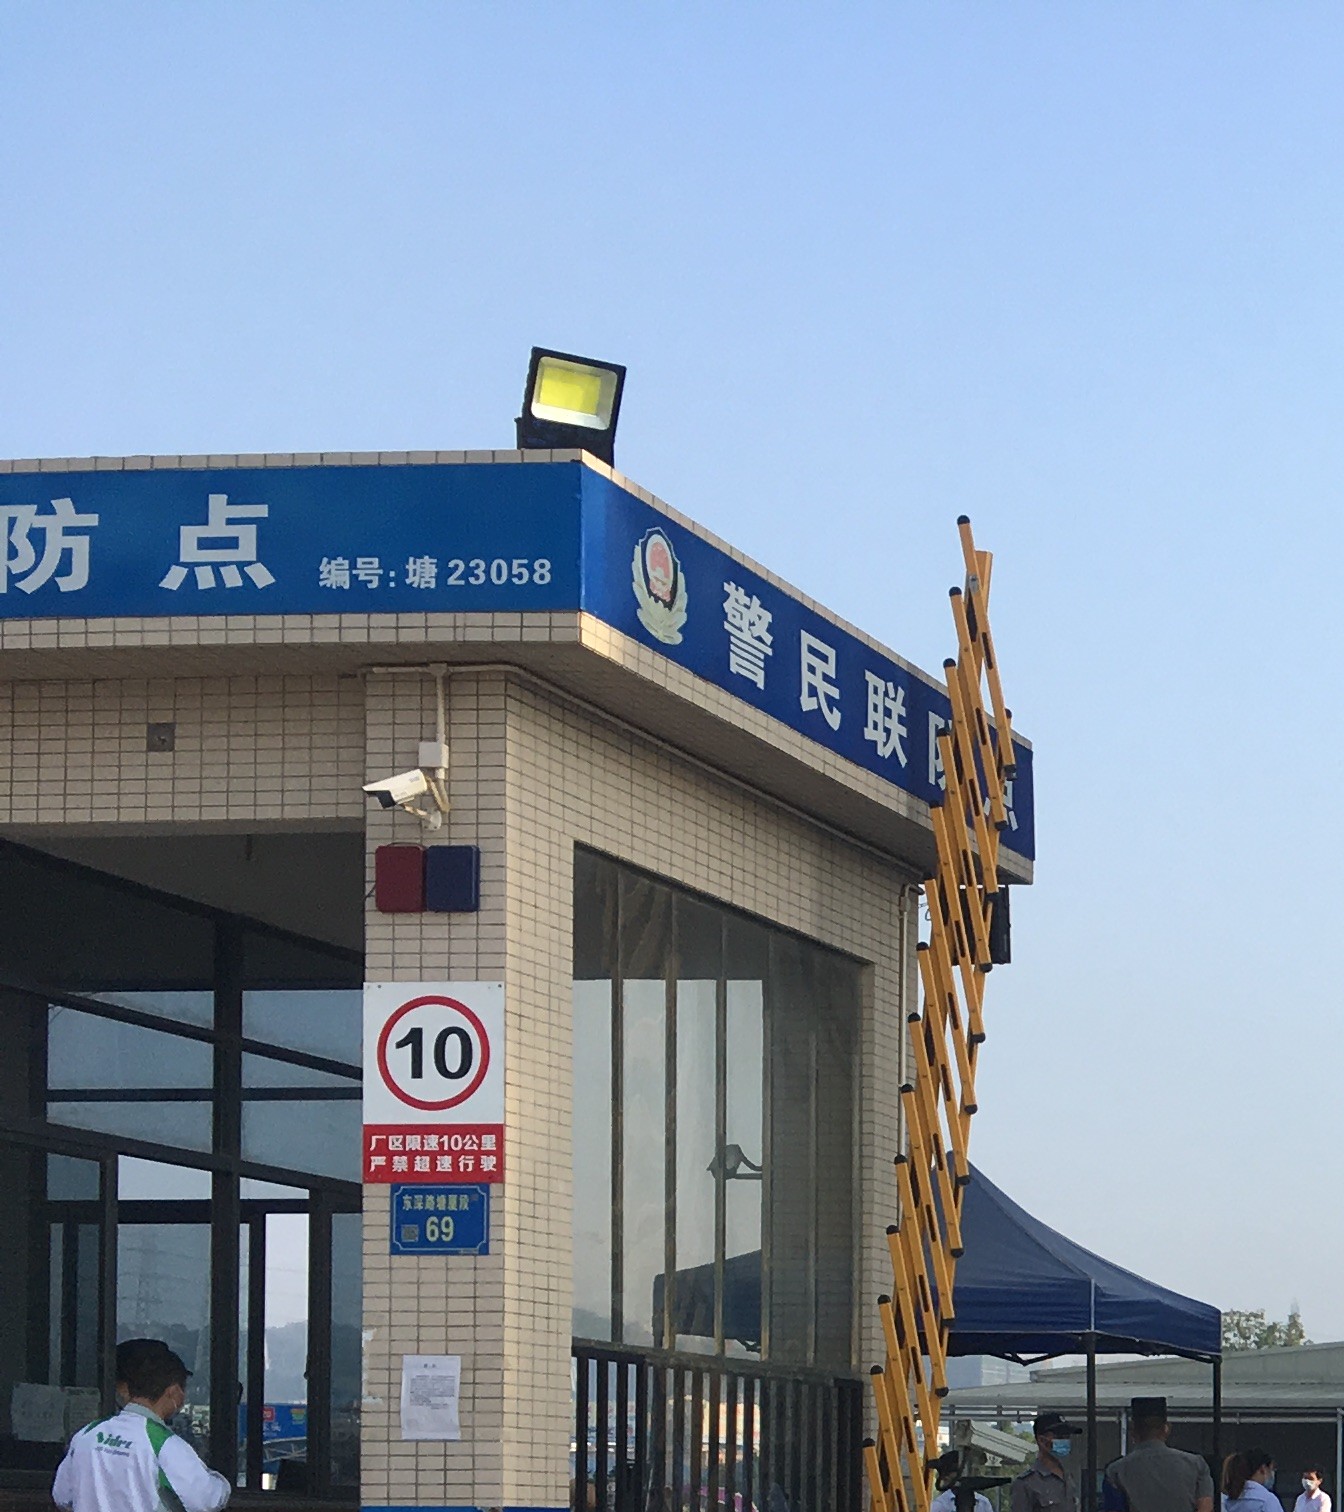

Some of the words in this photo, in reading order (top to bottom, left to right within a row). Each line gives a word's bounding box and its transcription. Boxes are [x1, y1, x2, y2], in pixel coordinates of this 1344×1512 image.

[722, 580, 1019, 832] 警民联
[395, 1026, 473, 1080] 10
[369, 1134, 497, 1151] 厂区限速10公里
[369, 1155, 497, 1172] 严禁超速行驶
[426, 1216, 454, 1242] 69
